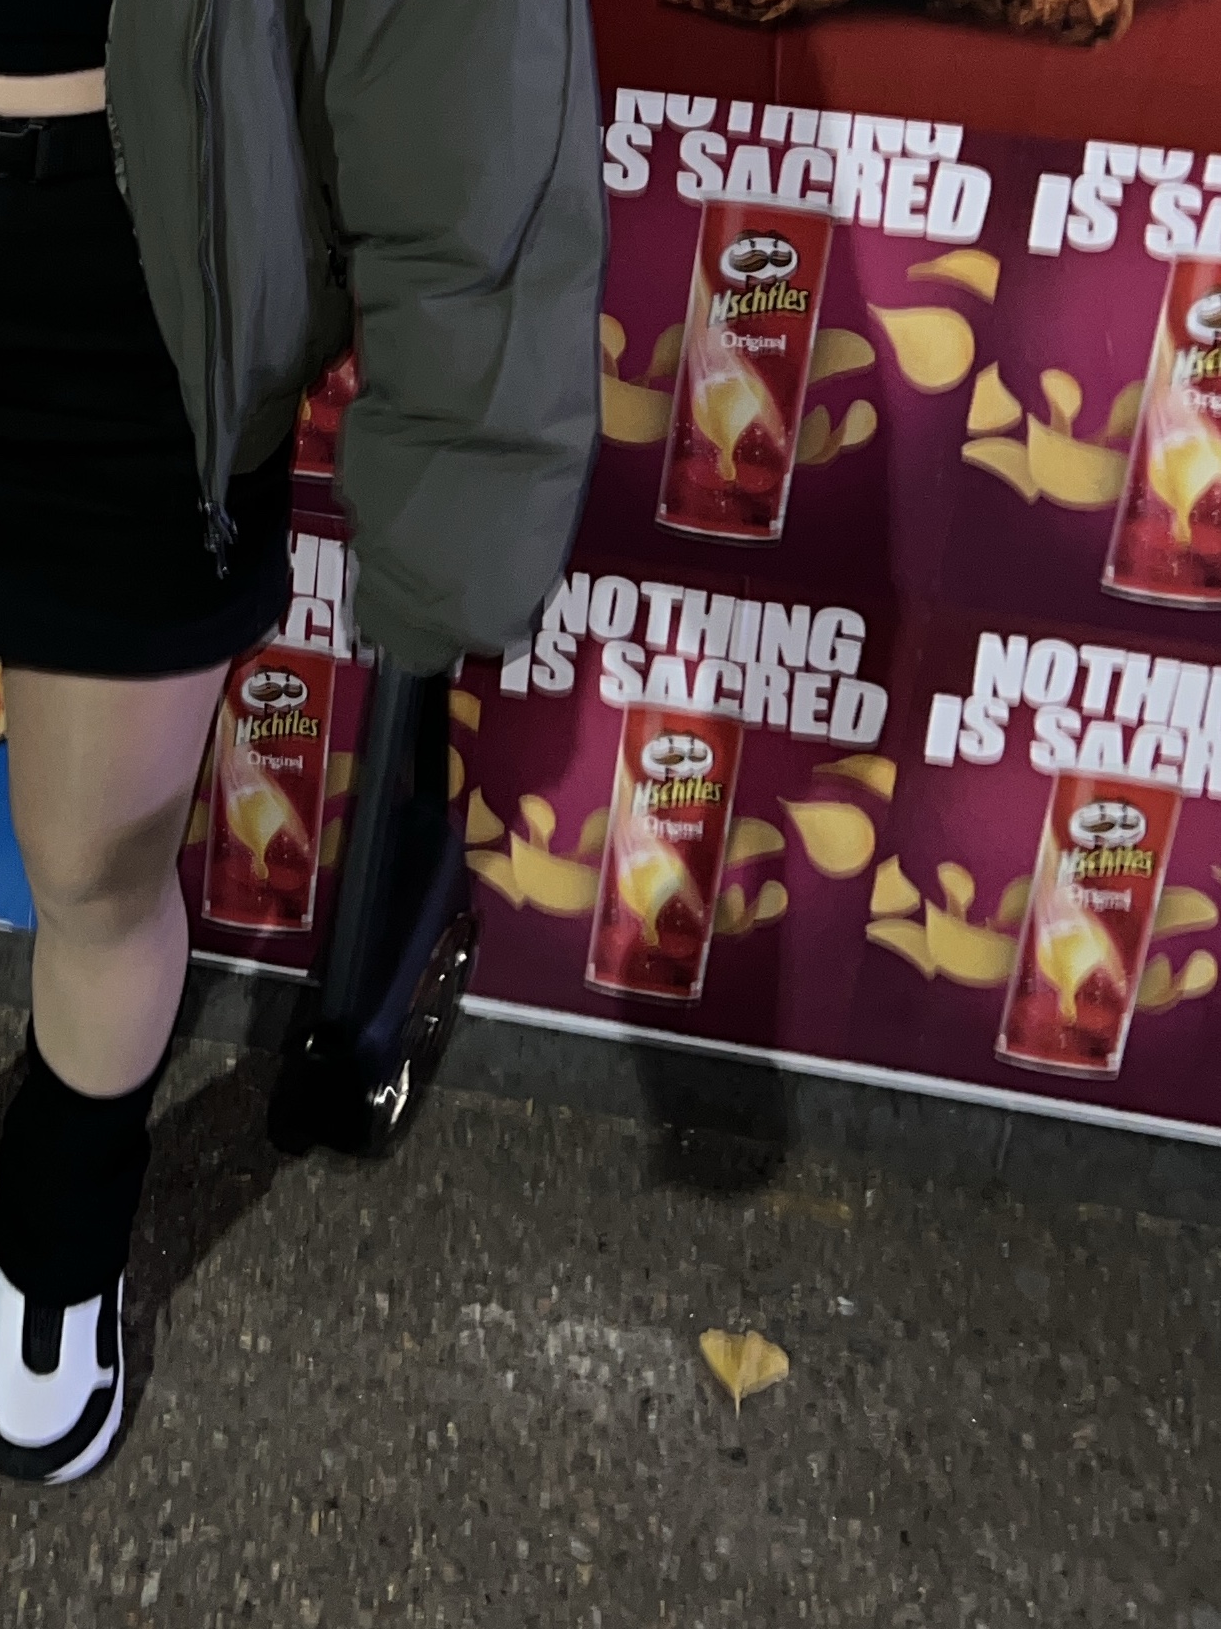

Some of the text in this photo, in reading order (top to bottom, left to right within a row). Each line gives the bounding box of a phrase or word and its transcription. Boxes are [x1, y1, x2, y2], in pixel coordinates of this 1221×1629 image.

[600, 122, 653, 198] S
[677, 130, 993, 245] SACRED
[1028, 172, 1123, 257] IS
[721, 331, 786, 354] Original
[542, 571, 866, 675] NOTHING
[499, 630, 889, 750] IS SACRED
[972, 631, 1221, 728] NOTHI
[925, 693, 1010, 767] IS
